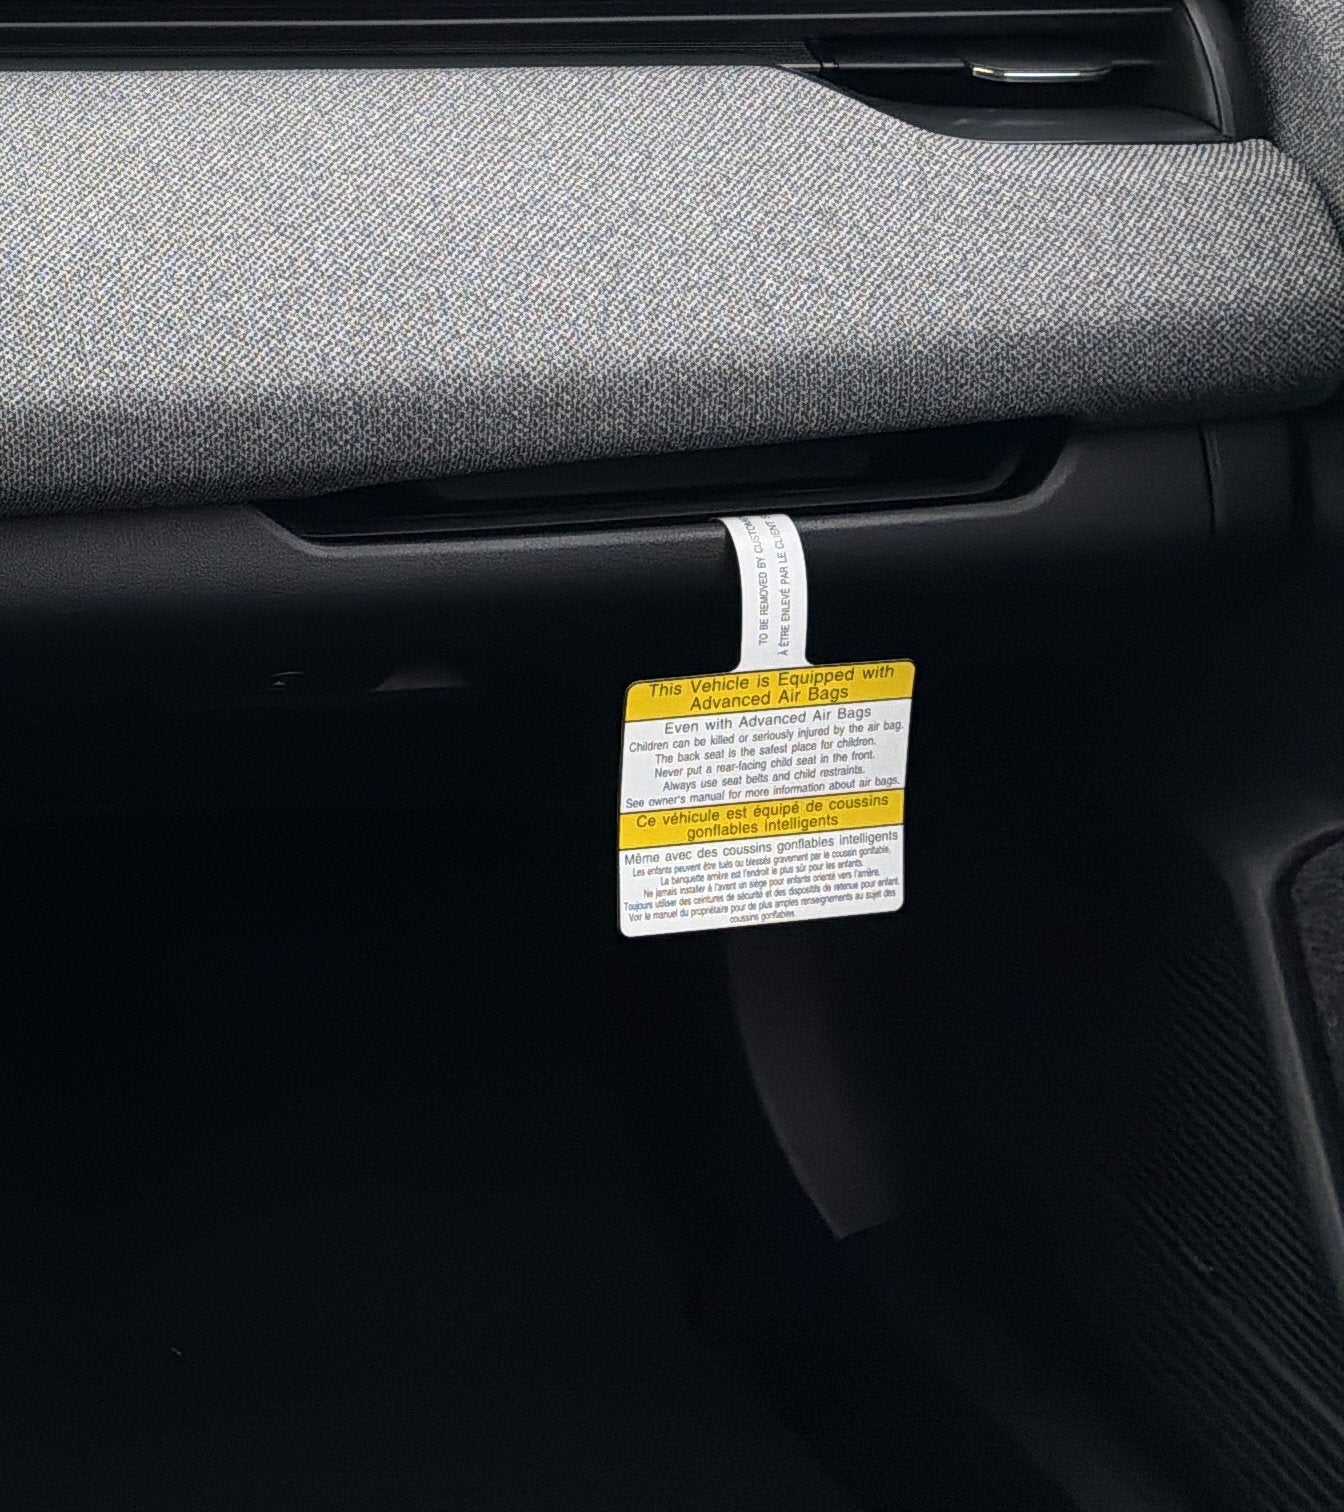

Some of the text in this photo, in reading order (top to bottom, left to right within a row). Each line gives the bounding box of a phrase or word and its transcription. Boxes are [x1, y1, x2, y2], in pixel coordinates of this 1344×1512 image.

[756, 556, 767, 569] BY
[776, 551, 788, 564] LE
[758, 633, 769, 646] TO
[649, 664, 894, 697] This Vehicle is Equipped with
[690, 686, 848, 711] Advanced Air Bags
[664, 707, 872, 735] Even with Advanced Air Bags
[636, 794, 889, 828] Ce véhicule est équipé de coussins
[687, 814, 839, 842] gonflables intelligents
[624, 830, 899, 866] Même avec des coussins gonflables intelligents
